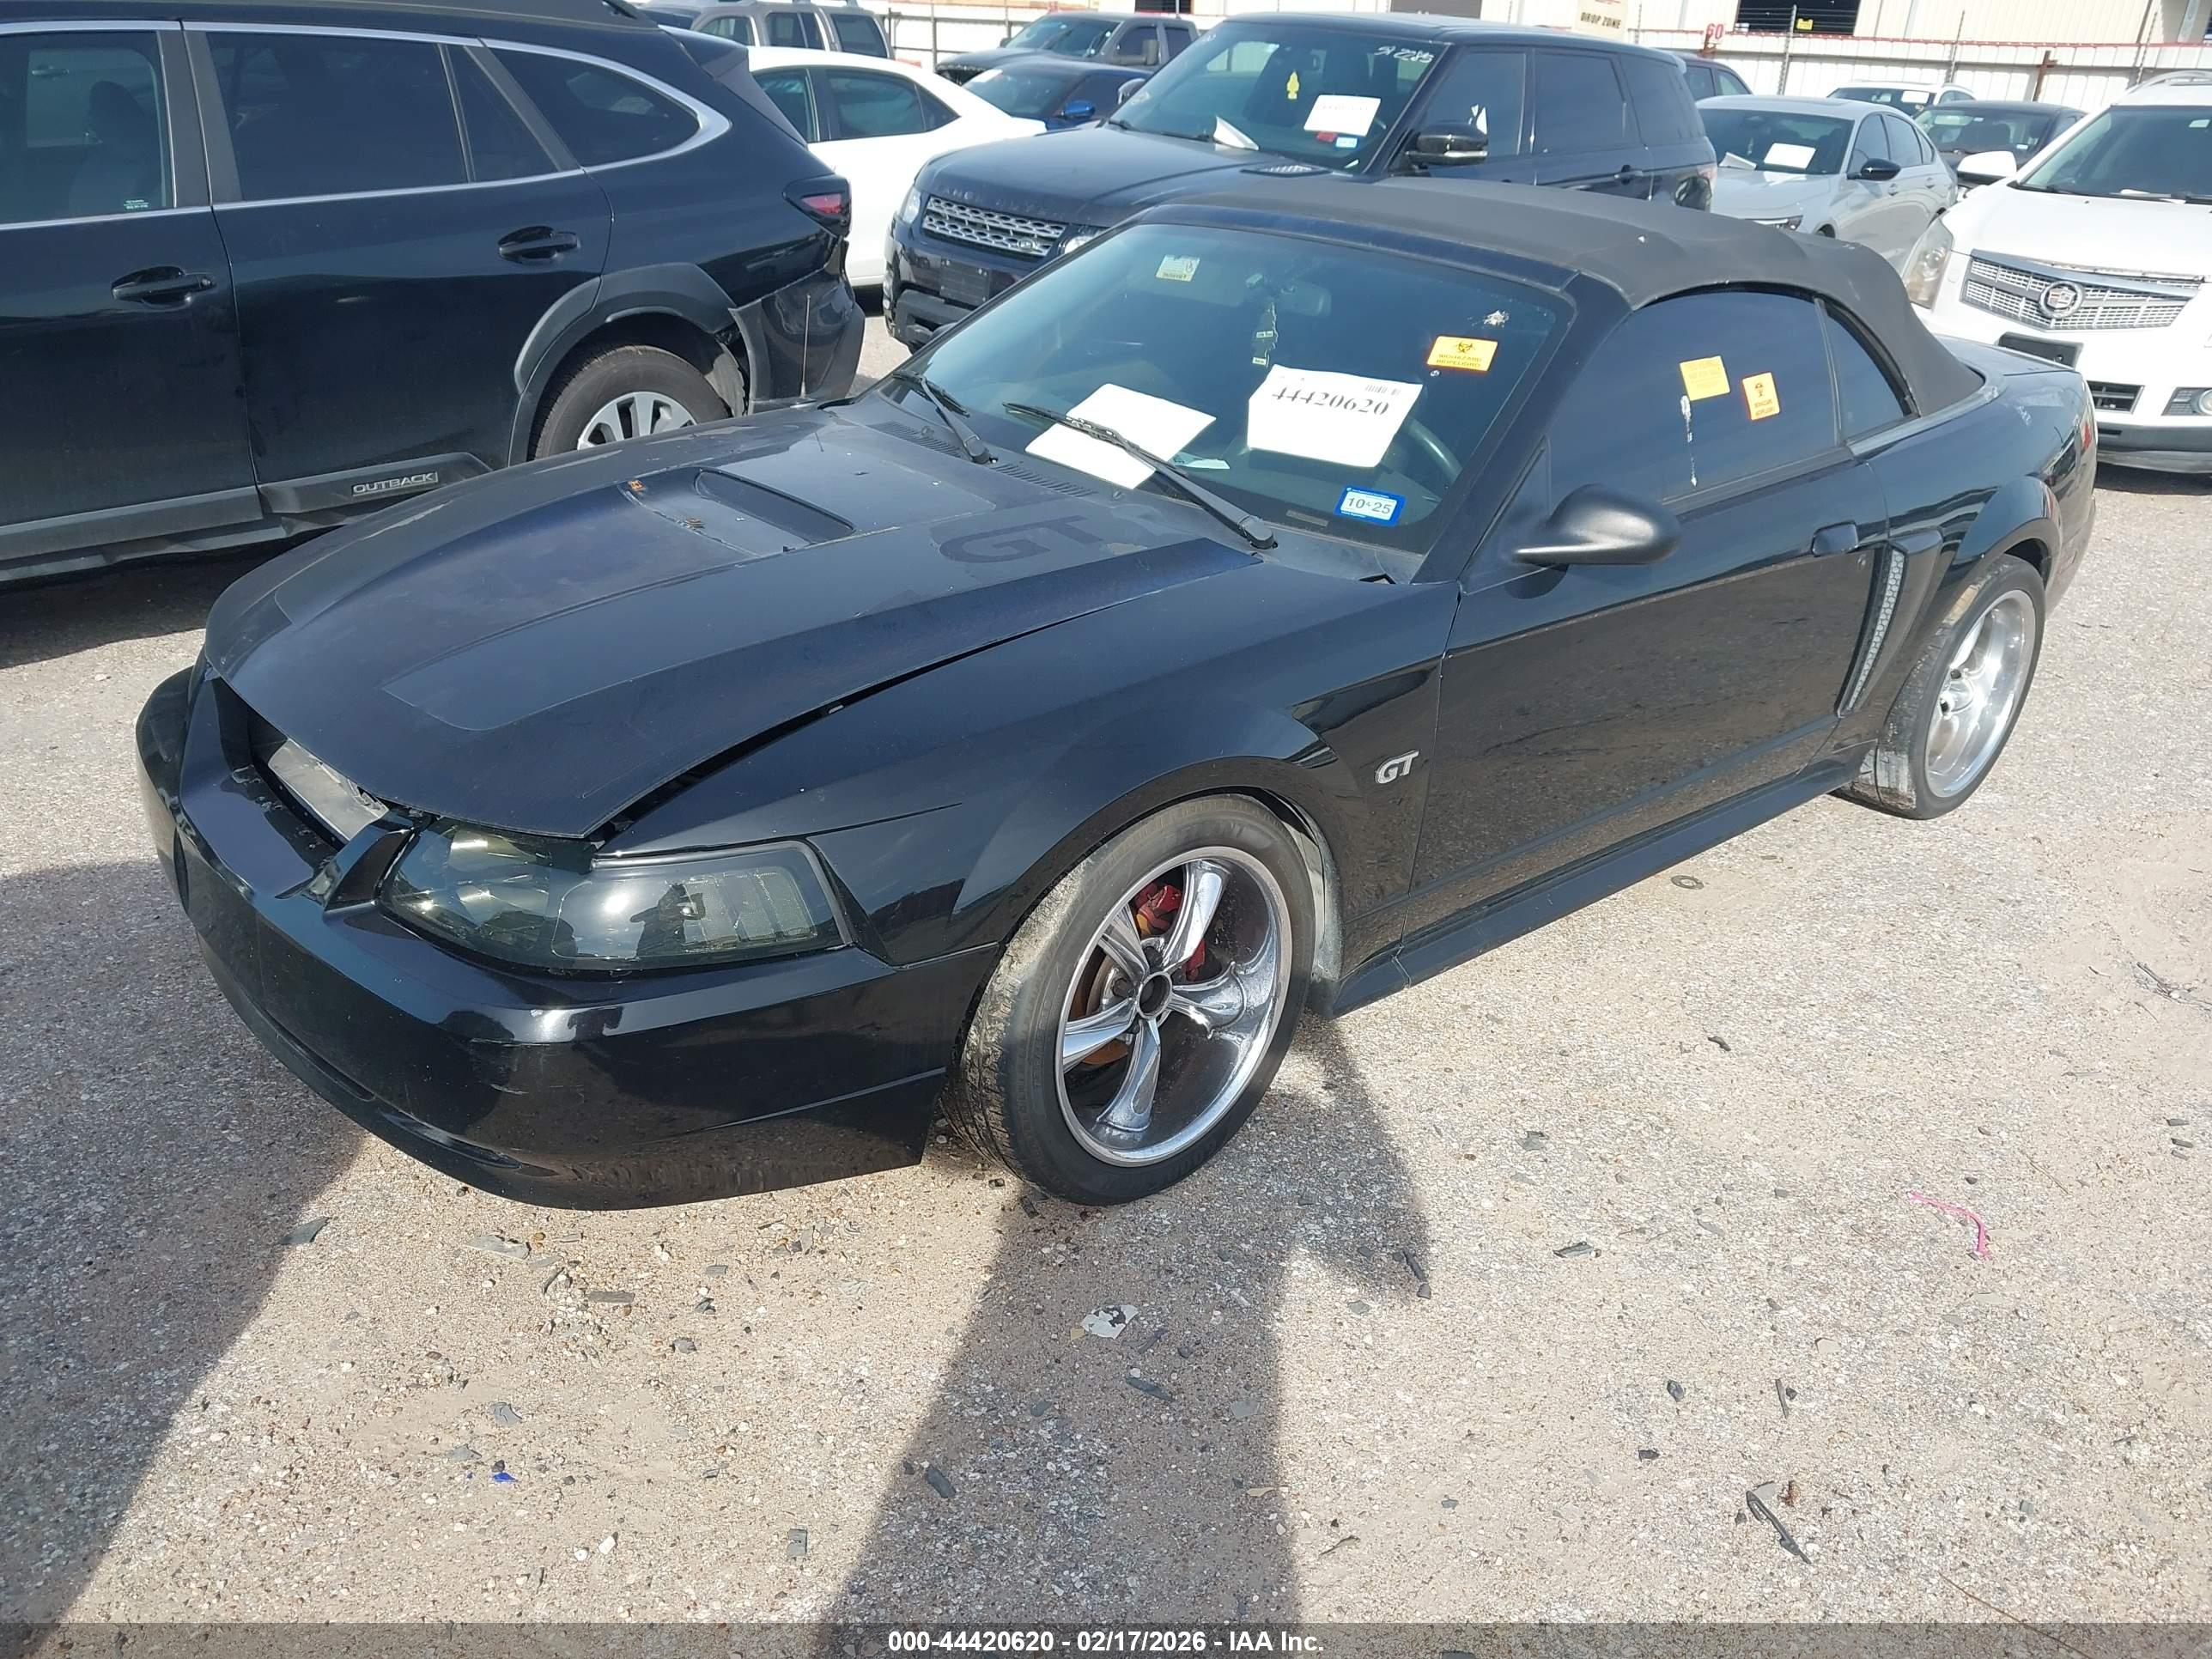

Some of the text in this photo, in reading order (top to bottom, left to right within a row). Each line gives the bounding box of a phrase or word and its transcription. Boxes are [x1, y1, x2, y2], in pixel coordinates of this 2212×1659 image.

[1581, 12, 1622, 29] DROP ZONE
[1272, 386, 1389, 416] 44420620
[353, 472, 434, 494] OUTBACK
[1348, 497, 1366, 509] 10
[1371, 501, 1393, 514] 25
[939, 515, 1104, 563] GT
[1376, 750, 1419, 784] GT
